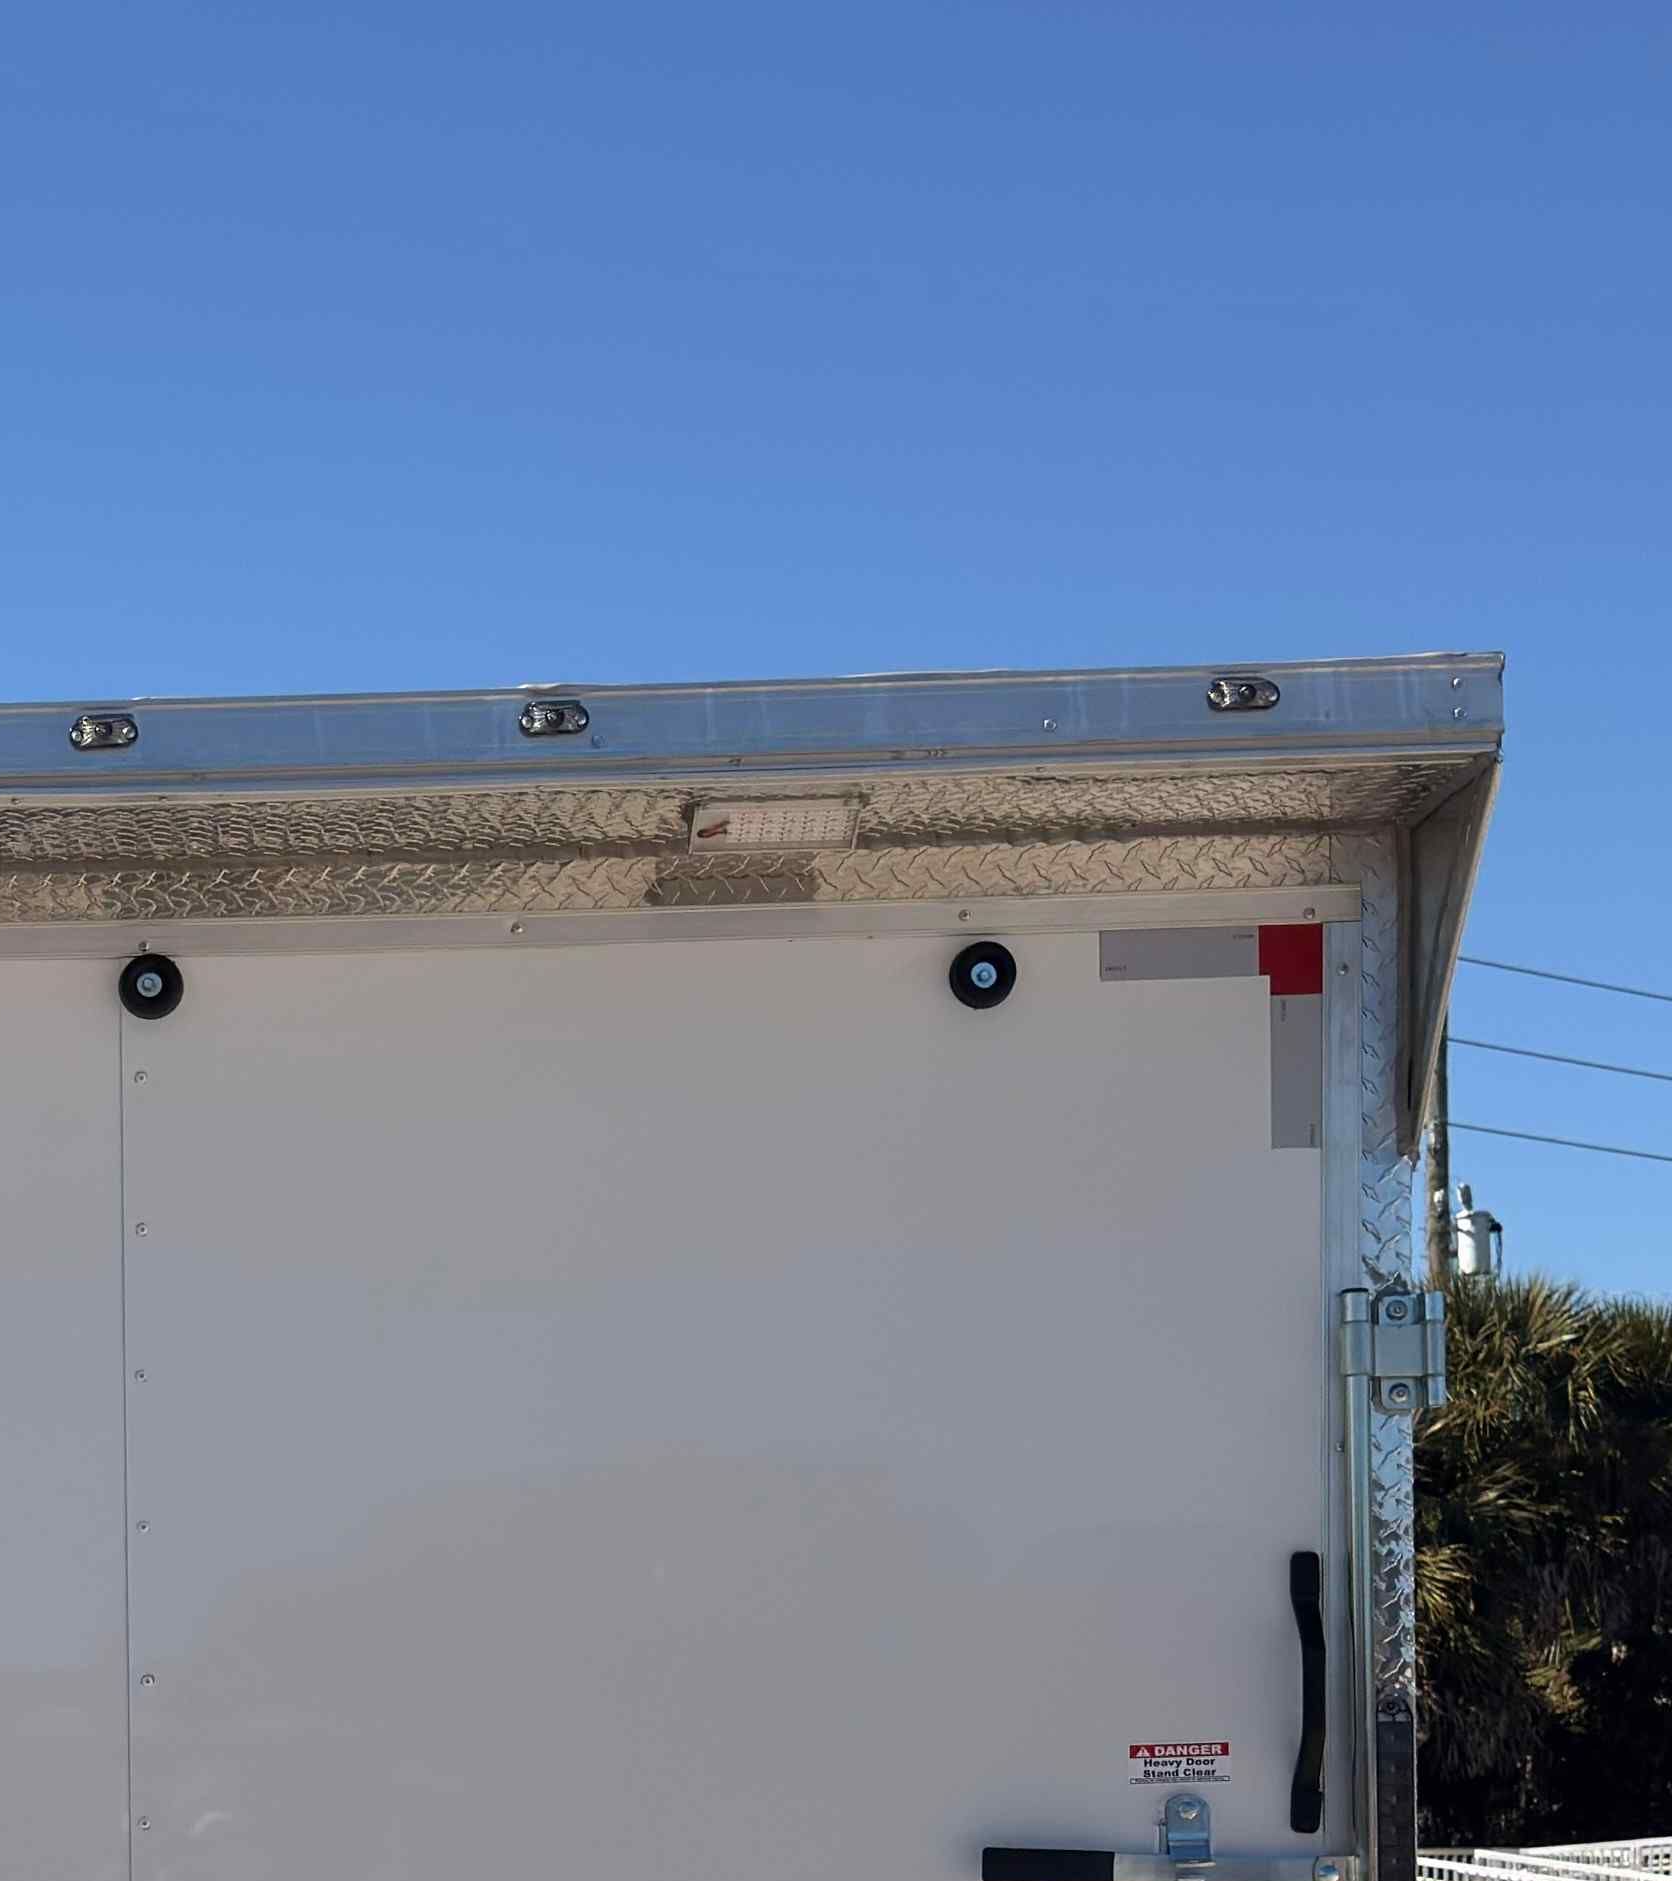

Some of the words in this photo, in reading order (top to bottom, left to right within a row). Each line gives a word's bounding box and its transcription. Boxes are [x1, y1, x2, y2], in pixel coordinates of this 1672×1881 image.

[1154, 1744, 1223, 1757] DANGER
[1144, 1758, 1182, 1768] Heavy
[1186, 1757, 1216, 1766] Door
[1143, 1768, 1179, 1778] Stand
[1183, 1767, 1216, 1777] Clear
